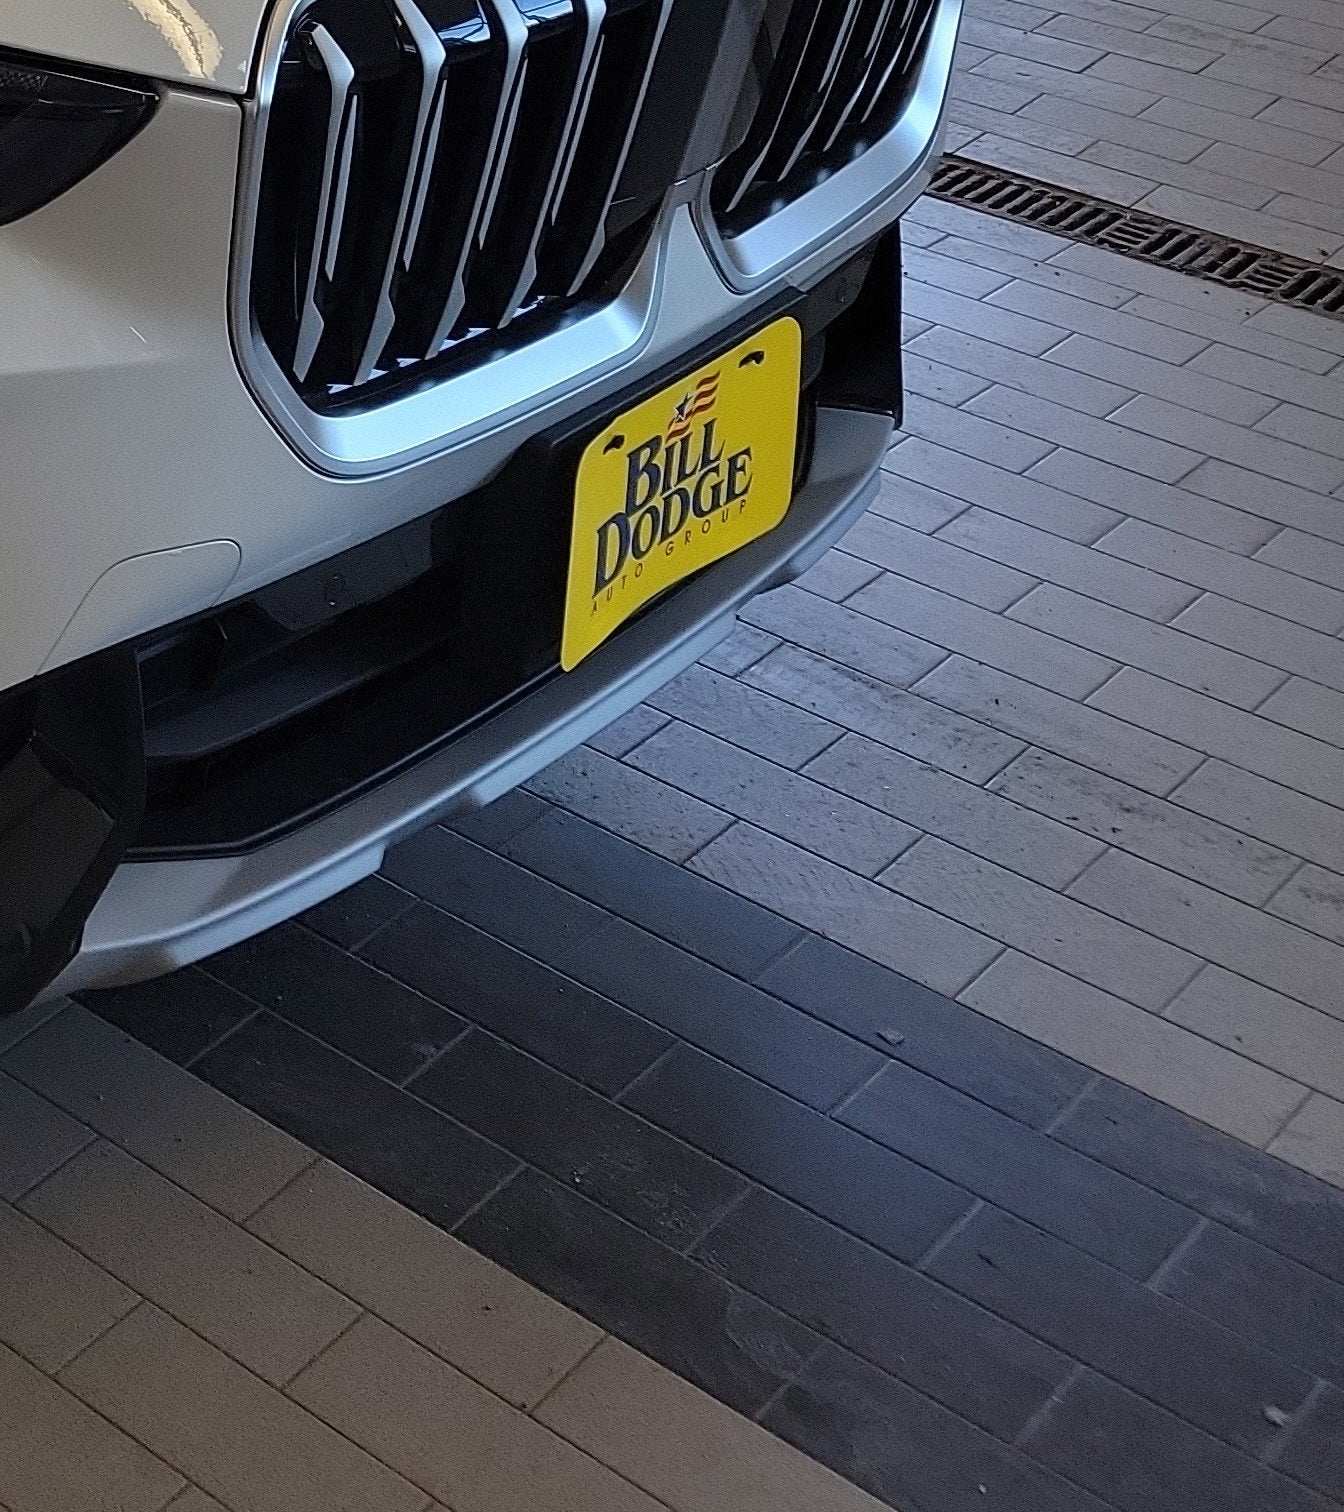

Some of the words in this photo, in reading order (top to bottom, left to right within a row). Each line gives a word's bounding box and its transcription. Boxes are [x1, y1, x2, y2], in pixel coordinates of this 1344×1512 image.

[592, 447, 753, 599] DODGE
[626, 418, 726, 518] BILL
[590, 562, 644, 617] AUTO
[665, 499, 747, 556] GROUP
